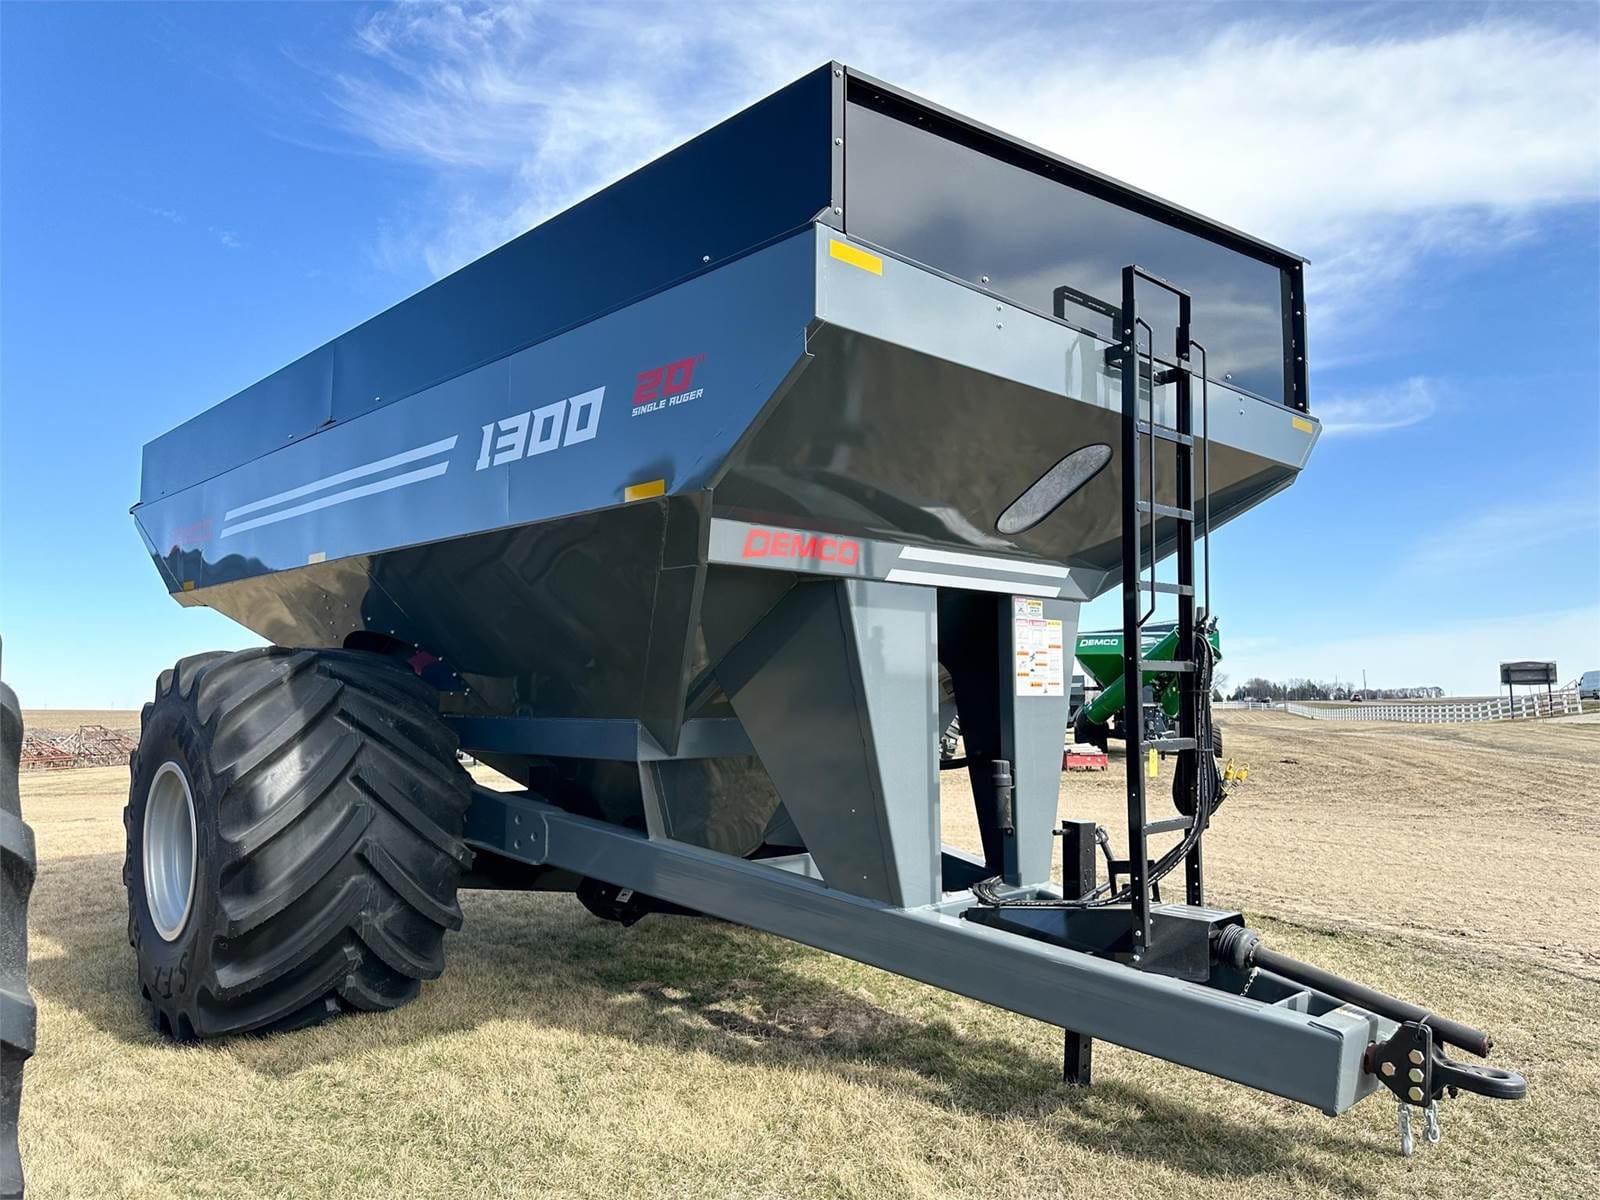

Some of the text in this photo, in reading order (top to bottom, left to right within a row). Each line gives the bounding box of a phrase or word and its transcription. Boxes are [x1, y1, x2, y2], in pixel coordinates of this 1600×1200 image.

[631, 388, 704, 417] SINGLE AUGER
[475, 386, 606, 471] 1300
[742, 529, 859, 566] DEMCO
[1079, 638, 1118, 647] DEMCO
